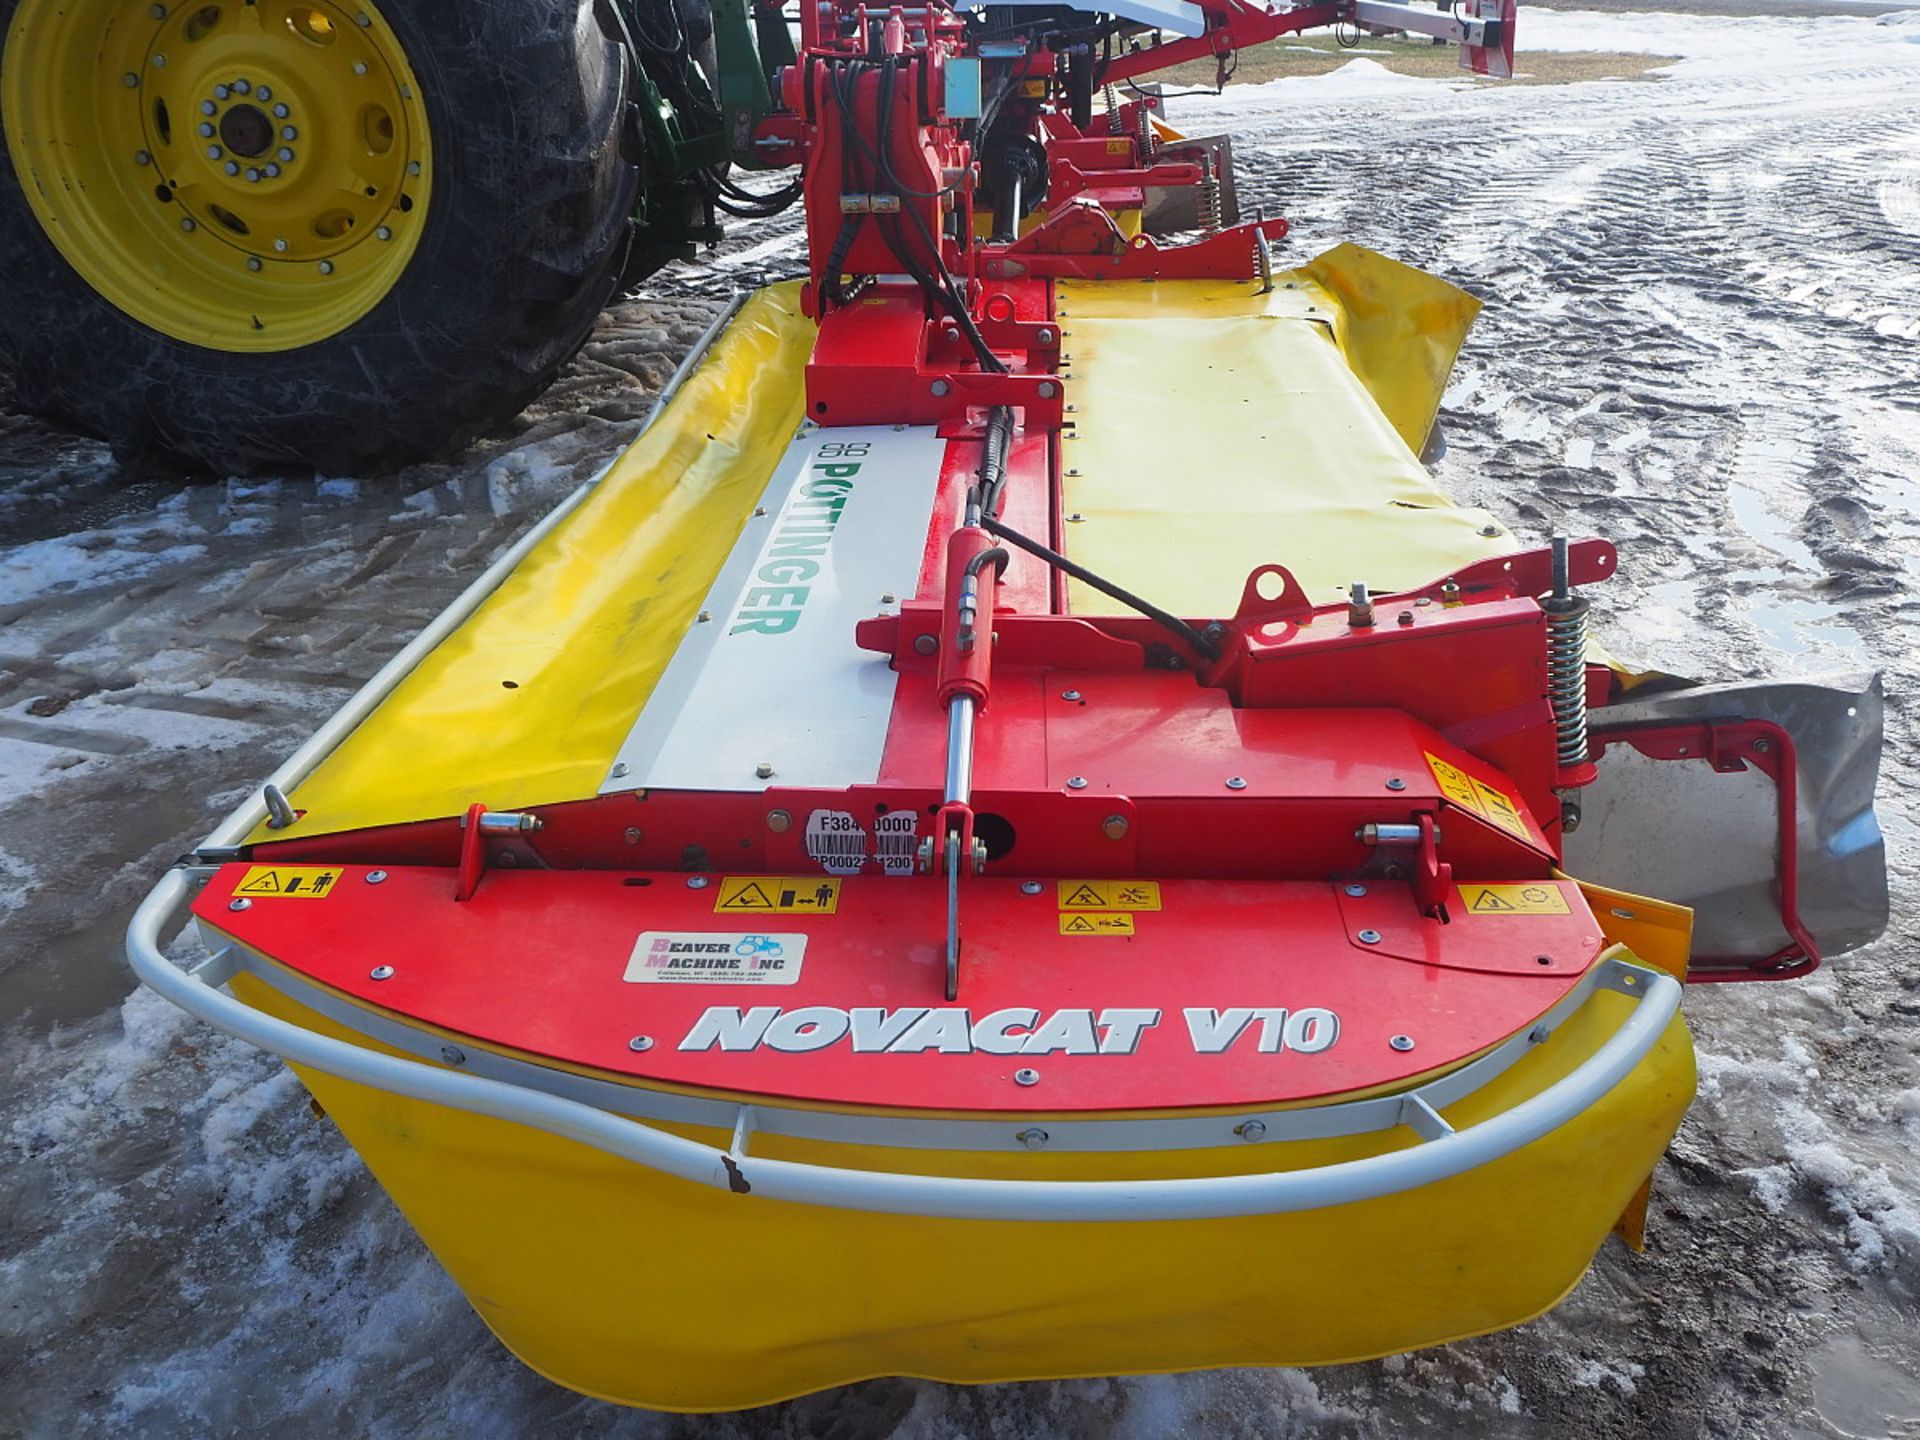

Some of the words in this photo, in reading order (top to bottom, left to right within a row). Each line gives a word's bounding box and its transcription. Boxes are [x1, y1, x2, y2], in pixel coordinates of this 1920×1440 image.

[650, 939, 730, 953] BEAVER
[645, 954, 741, 969] MACHINE
[748, 956, 785, 970] INC
[677, 1006, 1162, 1055] NOVACAT
[1182, 1007, 1341, 1055] V10
